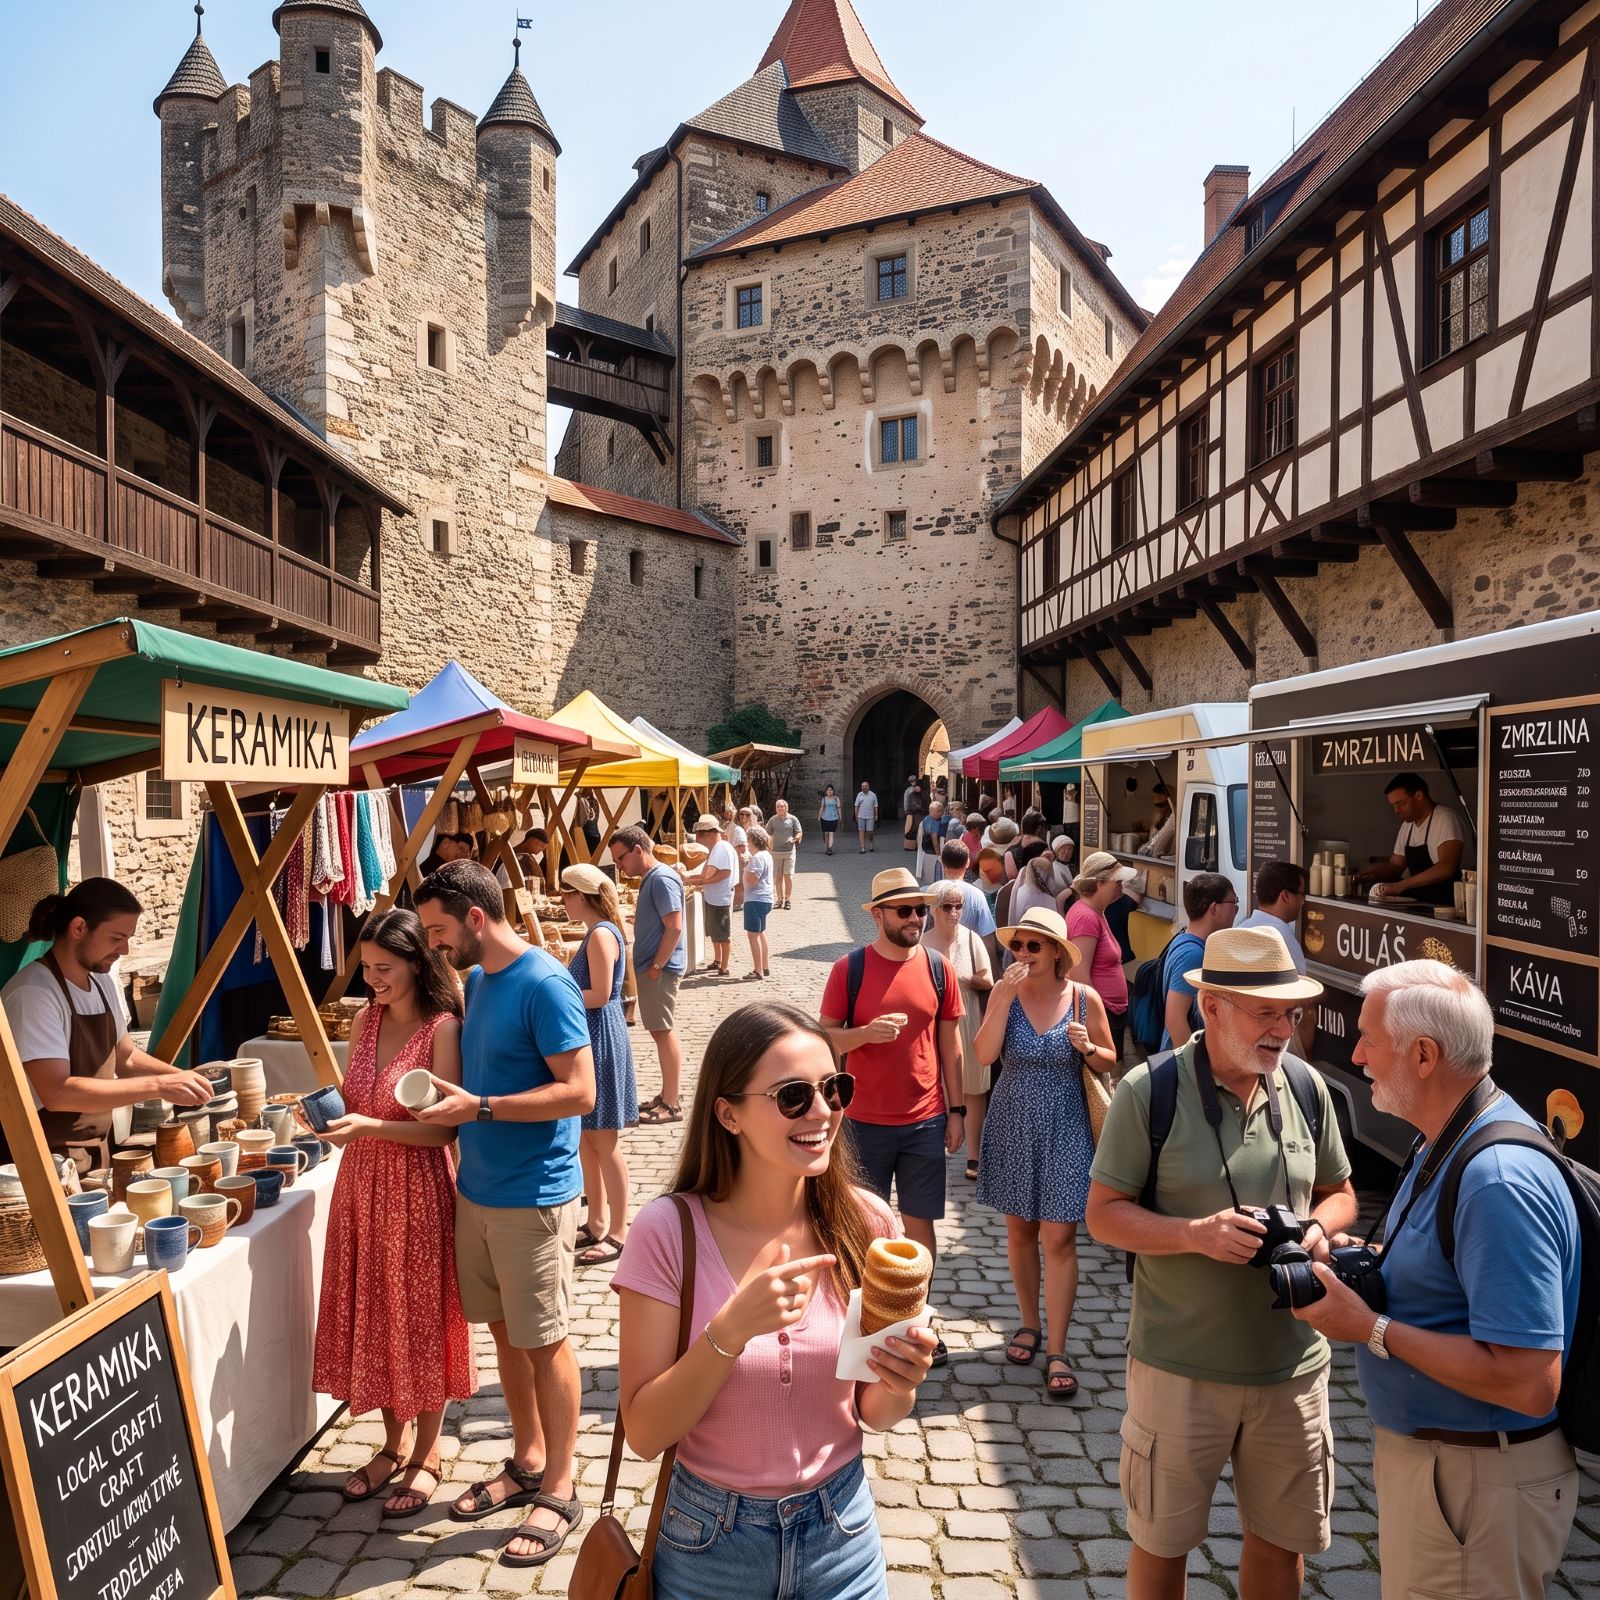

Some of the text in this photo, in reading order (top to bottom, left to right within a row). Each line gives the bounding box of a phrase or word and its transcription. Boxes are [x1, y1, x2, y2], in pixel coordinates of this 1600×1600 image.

[187, 702, 337, 770] KERAMIKA
[1322, 732, 1425, 767] ZMRZLINA
[1501, 718, 1590, 749] ZMRZLINA
[1336, 923, 1406, 967] GULÁŠ
[1510, 962, 1563, 1005] KÁVA
[29, 1323, 162, 1448] KERAMIKA
[57, 1445, 109, 1501] LOCAL
[99, 1451, 144, 1508] CRAFT
